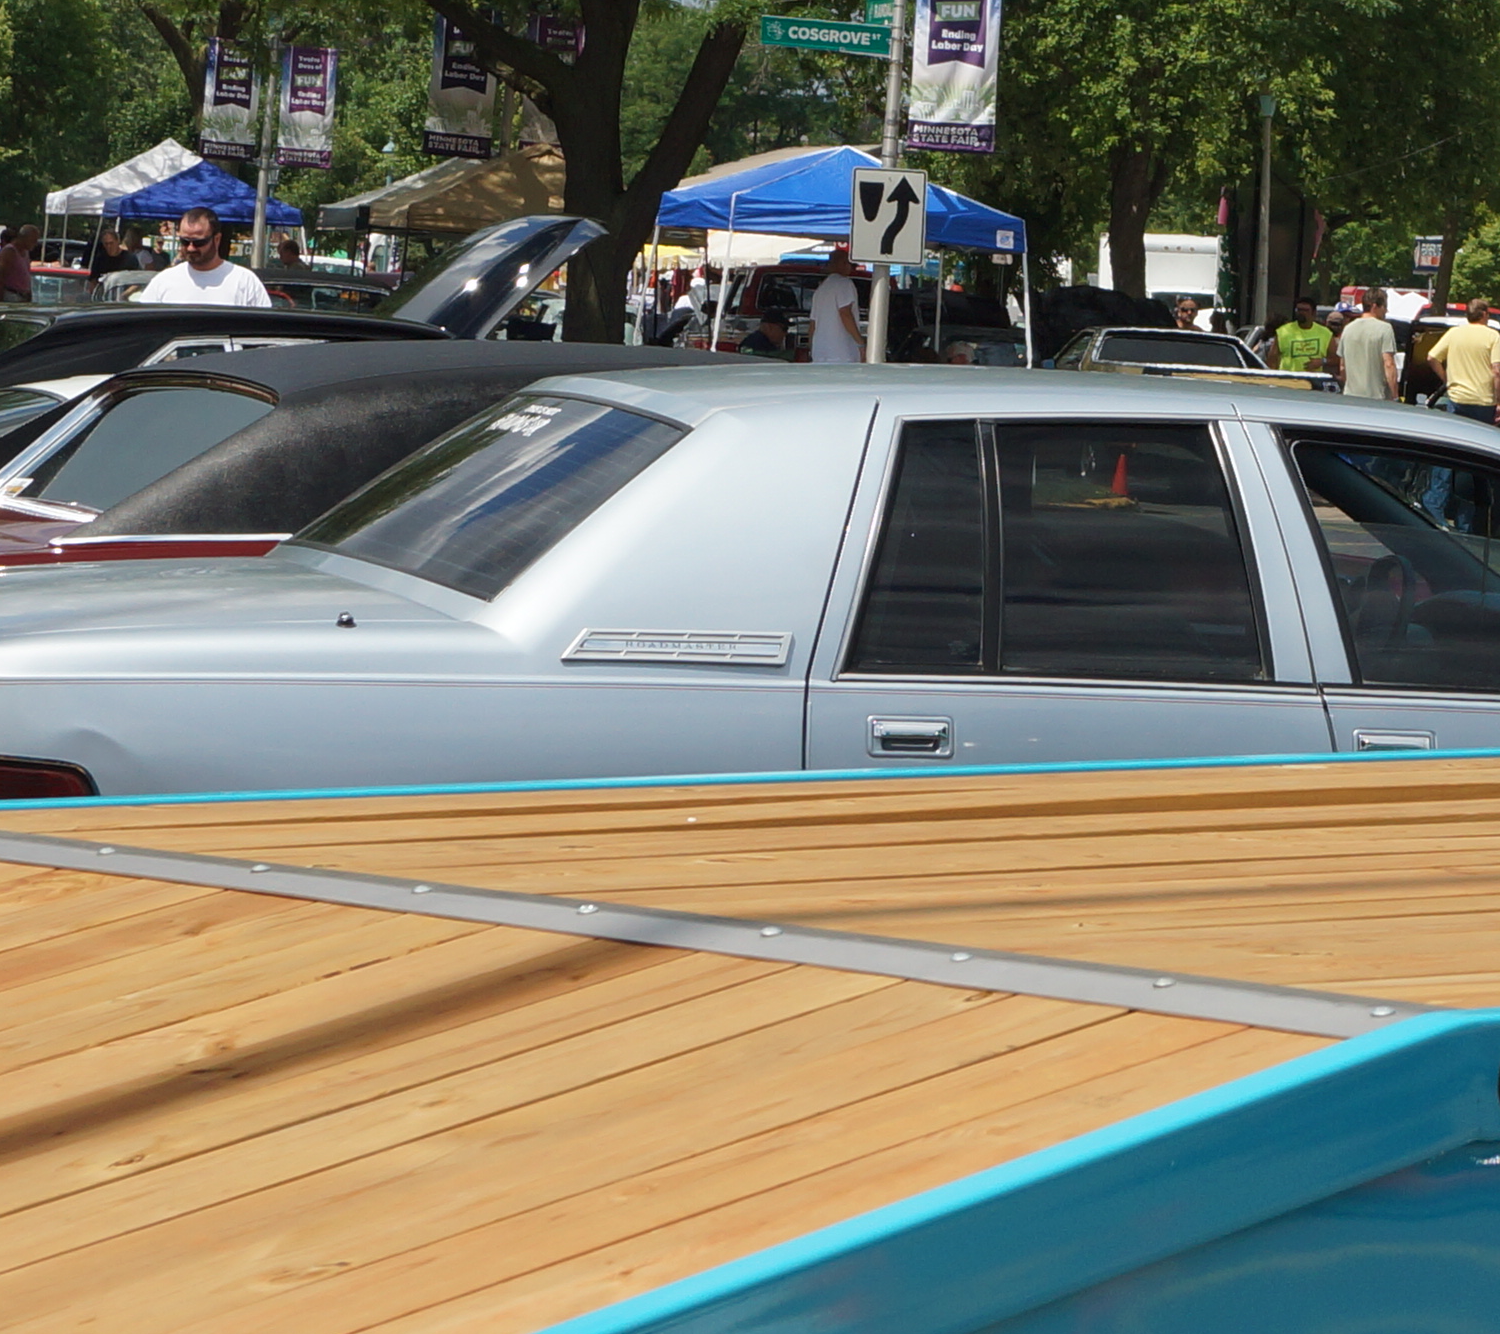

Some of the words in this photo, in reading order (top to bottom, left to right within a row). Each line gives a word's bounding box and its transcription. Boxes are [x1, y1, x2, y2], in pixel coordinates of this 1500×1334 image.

[941, 4, 976, 18] FUN
[788, 26, 871, 46] COSGROVE
[872, 33, 882, 41] ST
[941, 28, 977, 41] Ending
[931, 39, 962, 51] Labor
[963, 43, 984, 53] Day
[444, 69, 468, 80] Labor
[469, 72, 485, 83] Day
[913, 123, 979, 136] MINNESOTA
[428, 141, 455, 151] STATE
[429, 134, 479, 147] MINNESOTA
[912, 133, 948, 143] STATE
[951, 135, 979, 147] FAIR
[624, 640, 738, 651] ROADMASTER
